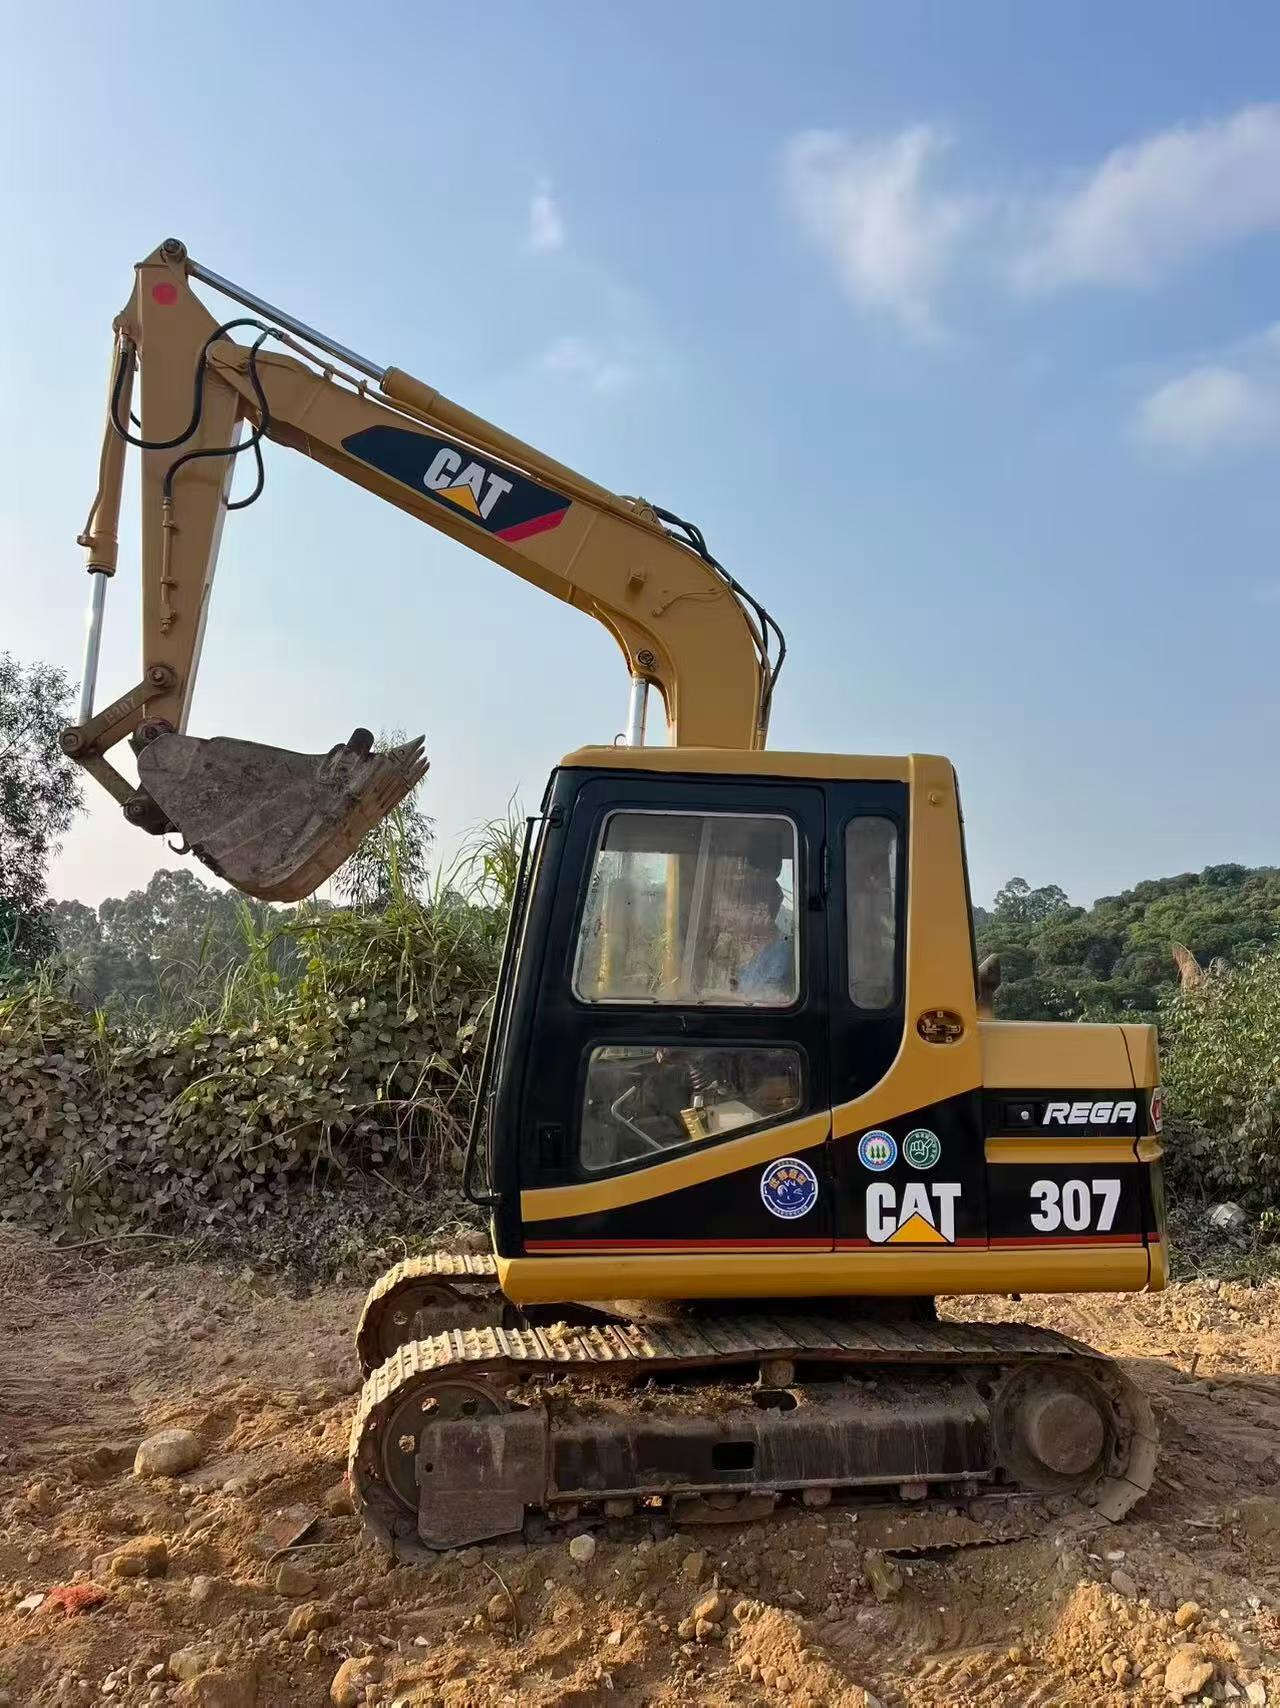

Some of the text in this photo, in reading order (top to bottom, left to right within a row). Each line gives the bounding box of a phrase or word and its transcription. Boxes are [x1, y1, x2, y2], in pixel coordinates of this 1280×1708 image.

[423, 447, 514, 520] CAT
[1042, 1101, 1137, 1125] REGA
[866, 1182, 962, 1243] CAT
[1030, 1179, 1121, 1232] 307
